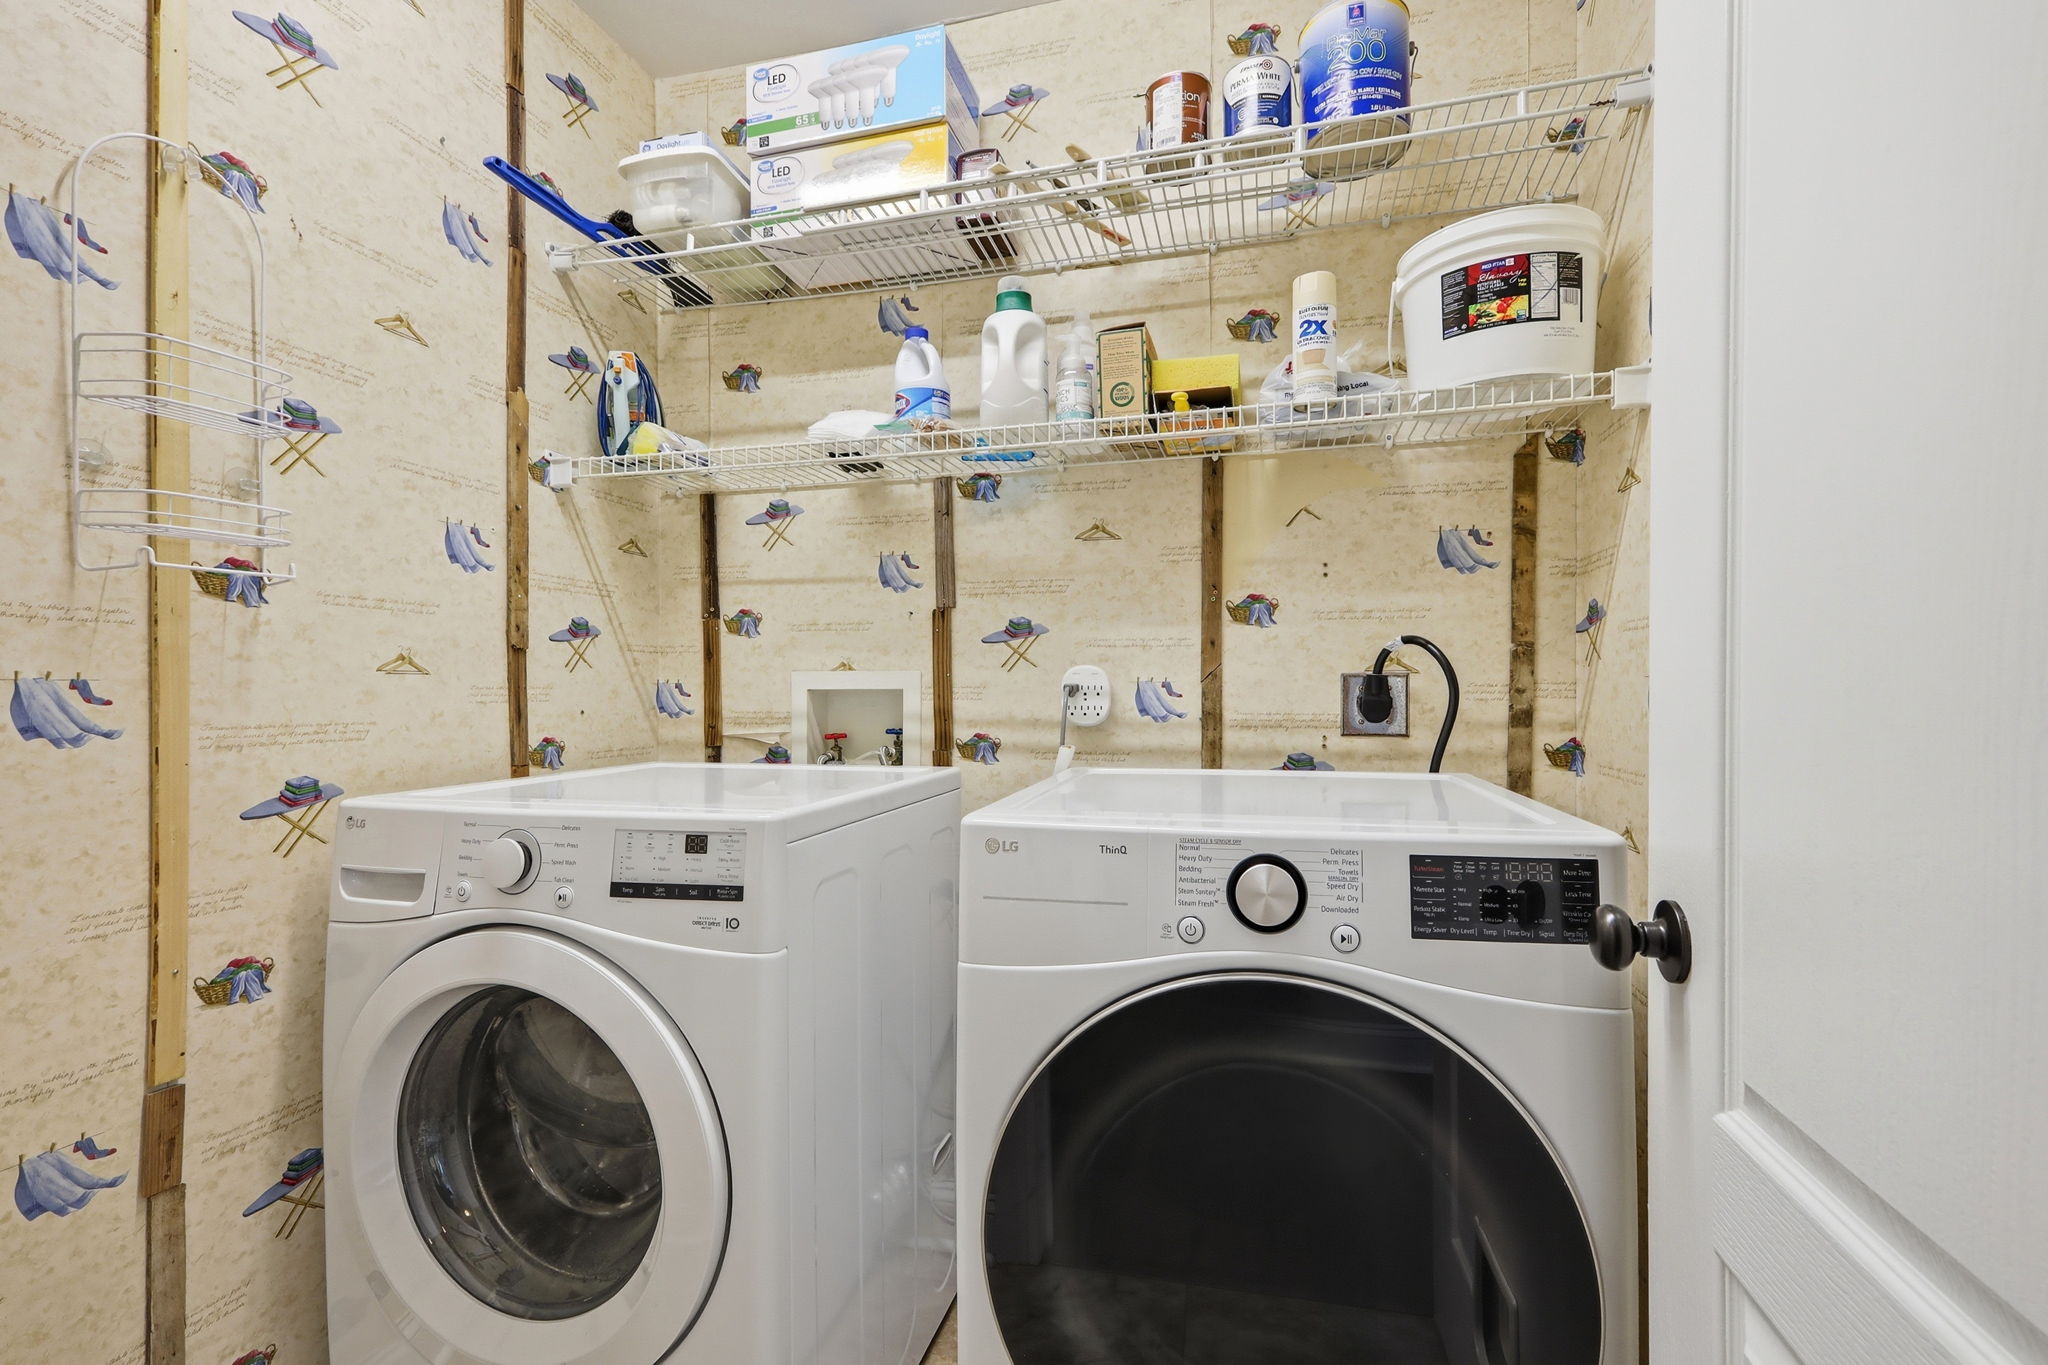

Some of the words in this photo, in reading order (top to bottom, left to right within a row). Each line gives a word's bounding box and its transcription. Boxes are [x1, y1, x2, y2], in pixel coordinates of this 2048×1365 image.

[1327, 26, 1386, 50] ProMar
[1327, 38, 1386, 73] 200
[767, 73, 786, 86] LED
[795, 115, 809, 126] 65
[656, 141, 681, 150] Daylight
[772, 166, 791, 178] LED
[1299, 319, 1328, 339] 2X
[1350, 381, 1369, 389] Local
[355, 818, 366, 829] LG
[1002, 840, 1019, 852] LG
[1099, 845, 1128, 855] ThinQ
[1179, 855, 1196, 863] Heavy
[1198, 855, 1212, 863] Duty
[1179, 865, 1202, 874] Bedding
[1326, 882, 1346, 890] Speed
[1347, 883, 1359, 891] Dry
[1178, 899, 1197, 907] Steam
[1347, 895, 1359, 903] Dry
[1321, 905, 1359, 914] Downloaded
[1450, 927, 1460, 935] Dry
